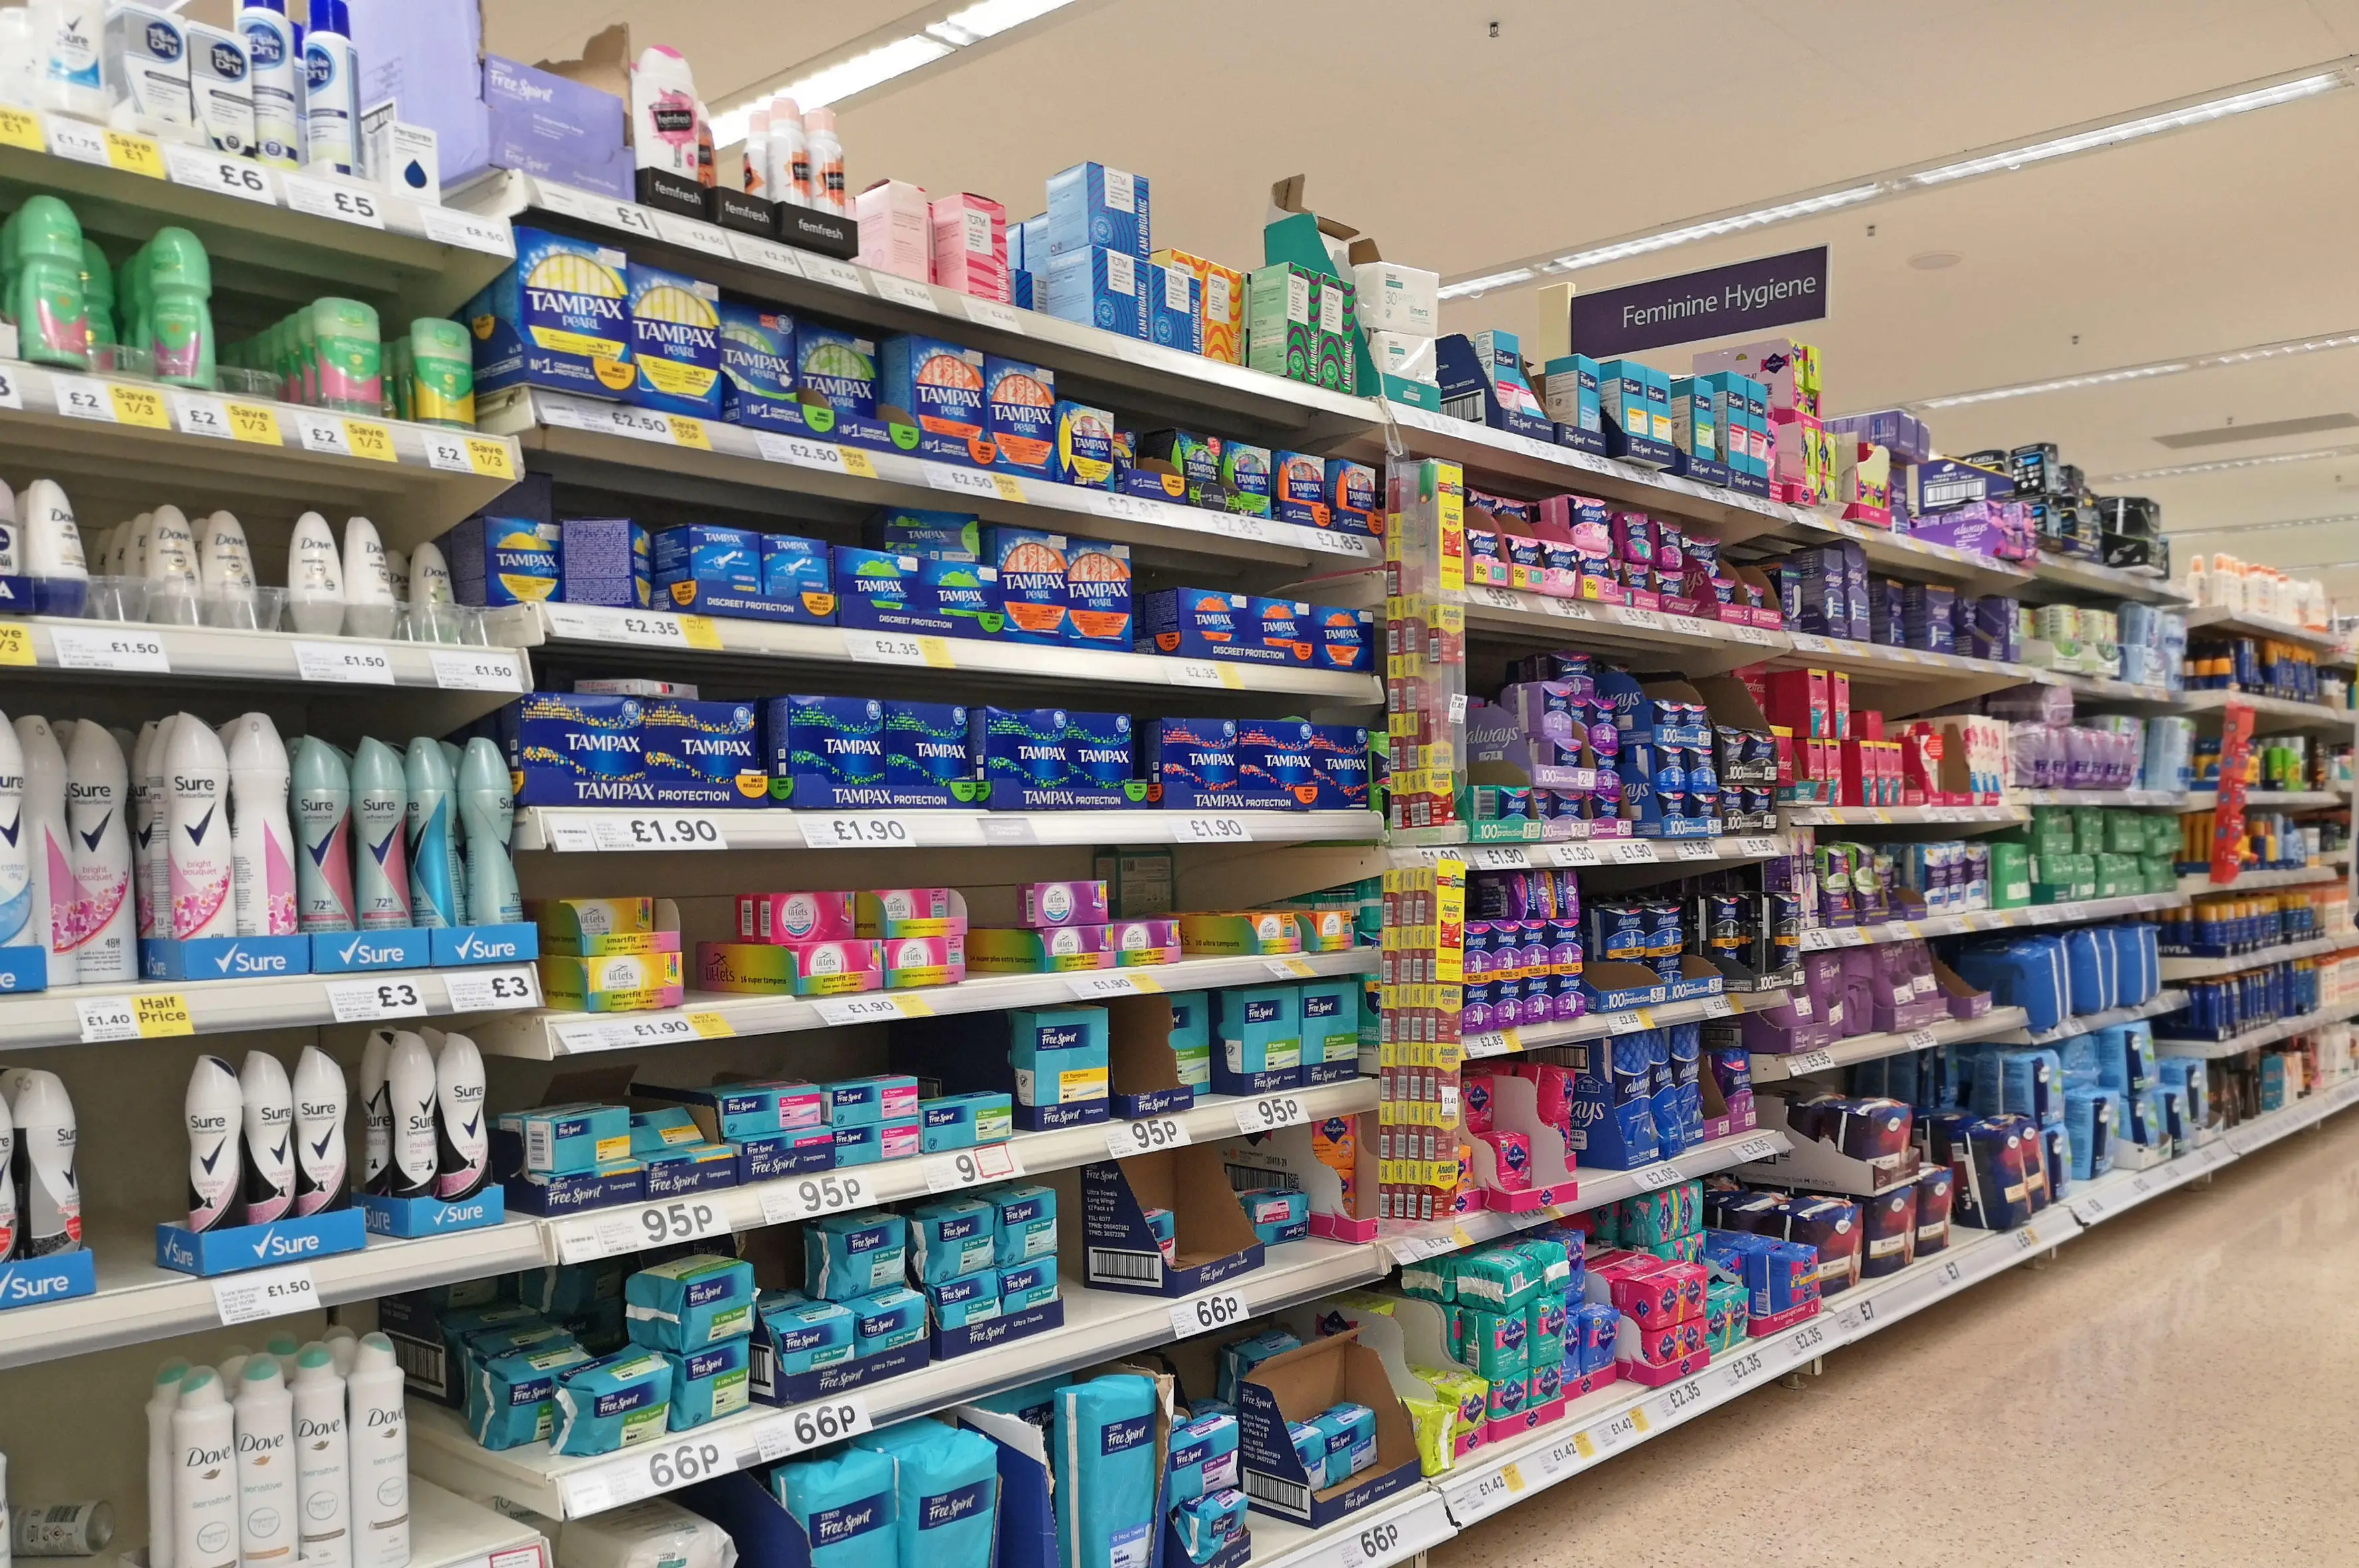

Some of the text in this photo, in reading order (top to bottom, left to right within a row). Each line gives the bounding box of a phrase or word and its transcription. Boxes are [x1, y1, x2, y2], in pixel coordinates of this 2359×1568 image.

[56, 133, 100, 152] £1.75
[109, 133, 152, 153] Save
[124, 146, 144, 161] £1
[219, 164, 264, 191] £6
[655, 180, 701, 206] femfresh
[334, 191, 375, 217] £5
[724, 200, 769, 225] femfresh
[617, 205, 649, 231] £1
[465, 226, 504, 244] £8.50
[798, 218, 843, 241] femfresh
[526, 290, 624, 320] TAMPAX
[1623, 276, 1816, 328] Feminine Hygiene
[633, 320, 716, 349] TAMPAX
[724, 348, 790, 373] TAMPAX
[114, 386, 156, 404] Save
[803, 375, 872, 399] TAMPAX
[70, 391, 99, 408] £2
[917, 385, 982, 408] TAMPAX
[126, 397, 155, 415] 1/3
[230, 405, 269, 421] Save
[992, 404, 1052, 425] TAMPAX
[190, 409, 216, 425] £2
[240, 416, 268, 432] 1/3
[611, 411, 667, 433] £2.50
[669, 417, 698, 431] Save
[439, 446, 461, 460] £2
[471, 441, 504, 455] Save
[791, 443, 838, 463] £2.50
[1073, 436, 1108, 452] TAMPAX
[479, 452, 502, 466] 1/3
[952, 472, 993, 490] £2.50
[1290, 481, 1320, 494] TAMPAX
[215, 532, 247, 547] Dove
[300, 537, 332, 551] Dove
[1316, 532, 1364, 551] £2.85
[496, 553, 556, 567] TAMPAX
[855, 580, 902, 592] TAMPAX
[1002, 573, 1065, 589] TAMPAX
[707, 597, 795, 613] DISCREET PROTECTION
[625, 619, 678, 637] £2.35
[879, 614, 952, 630] DISCREET PROTECTION
[1195, 614, 1231, 625] TAMPAX
[111, 641, 159, 656] £1.50
[876, 640, 919, 656] £2.35
[1213, 646, 1285, 659] DISCREET PROTECTION
[344, 655, 385, 668] £1.50
[475, 665, 512, 677] £1.50
[565, 734, 641, 753] TAMPAX
[1467, 725, 1518, 745] always
[682, 739, 751, 756] TAMPAX
[824, 739, 880, 755] TAMPAX
[1019, 745, 1066, 760] TAMPAX
[1189, 753, 1235, 765] TAMPAX
[1326, 758, 1366, 770] TAMPAX
[70, 783, 112, 799] Sure
[174, 776, 215, 793] Sure
[574, 782, 730, 801] TAMPAX PROTECTION
[832, 788, 947, 805] TAMPAX PROTECTION
[1023, 791, 1073, 805] TAMPAX
[1194, 794, 1291, 807] TAMPAX PROTECTION
[300, 799, 334, 813] Sure
[631, 820, 717, 844] £1.90
[834, 819, 906, 840] £1.90
[1191, 819, 1243, 837] £1.90
[1480, 825, 1497, 838] 100
[1487, 850, 1524, 865] £1.90
[1562, 848, 1594, 862] £1.90
[1621, 846, 1651, 860] £1.90
[82, 866, 108, 878] bright
[1617, 915, 1641, 926] always
[358, 945, 404, 965] Sure
[473, 940, 516, 959] Sure
[235, 953, 286, 973] Sure
[492, 977, 529, 999] £3
[748, 977, 762, 985] super
[1094, 978, 1130, 991] £1.90
[140, 995, 175, 1011] Half
[377, 985, 417, 1009] £3
[1608, 993, 1623, 1009] 100
[138, 1007, 187, 1025] Price
[849, 1001, 894, 1014] £1.90
[87, 1015, 130, 1027] £1.40
[634, 1021, 688, 1037] £1.90
[1043, 1032, 1077, 1045] Free Spirit
[1481, 1034, 1503, 1047] £2.85
[1625, 1078, 1650, 1094] always
[301, 1102, 336, 1116] Sure
[1258, 1098, 1298, 1125] 95p
[191, 1114, 225, 1129] Sure
[1132, 1119, 1177, 1149] 95p
[1742, 1140, 1769, 1155] £2.05
[751, 1161, 770, 1175] Free
[771, 1156, 797, 1173] Spirit
[1437, 1164, 1457, 1174] Anadin
[650, 1169, 731, 1193] Free Spirit Tampons
[1646, 1167, 1678, 1184] £2.05
[548, 1181, 637, 1206] Free Spirit Tampons
[799, 1176, 861, 1211] 95p
[447, 1204, 483, 1221] Sure
[642, 1204, 713, 1242] 95p
[271, 1235, 319, 1256] Sure
[11, 1274, 68, 1298] Sure
[267, 1281, 310, 1298] £1.50
[1196, 1298, 1237, 1327] 66p
[1859, 1301, 1873, 1321] £7
[1795, 1327, 1822, 1349] £2.35
[820, 1356, 905, 1389] Free Spirit Ultra Towels
[1733, 1353, 1762, 1377] £2.35
[1669, 1383, 1700, 1408] £2.35
[299, 1418, 340, 1438] Dove
[794, 1403, 855, 1444] 66p
[241, 1434, 284, 1452] Dove
[1554, 1443, 1576, 1461] £1.42
[187, 1446, 230, 1468] Dove
[649, 1444, 720, 1488] 66p
[1481, 1476, 1504, 1496] £1.42
[820, 1509, 872, 1537] Free Spirit
[1360, 1522, 1398, 1558] 66p
